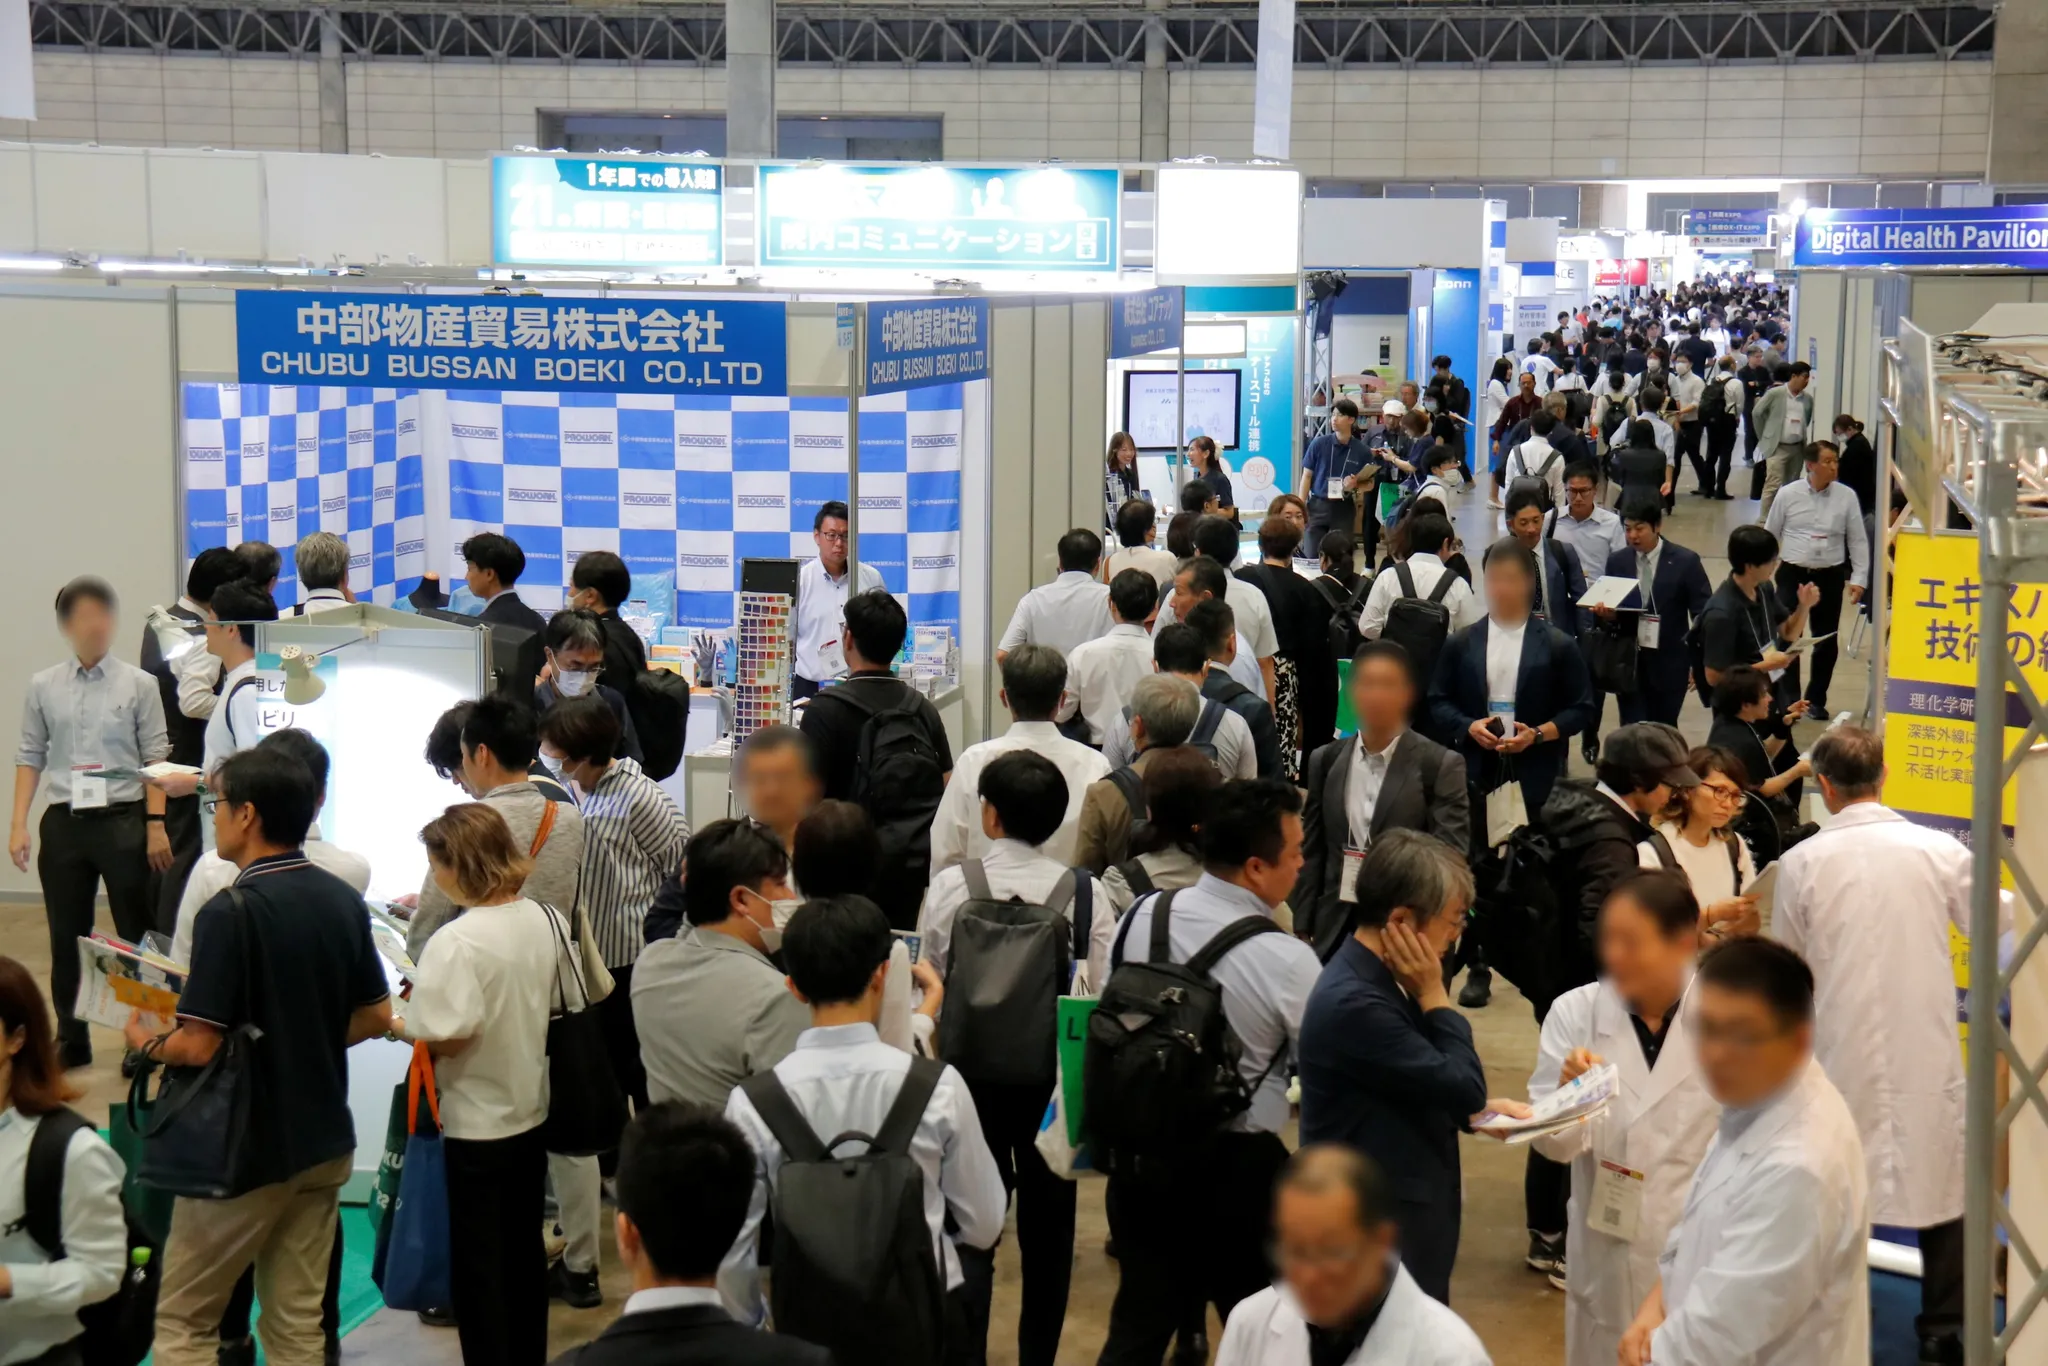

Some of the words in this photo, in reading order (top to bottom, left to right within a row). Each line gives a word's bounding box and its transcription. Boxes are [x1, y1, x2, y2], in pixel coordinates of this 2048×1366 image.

[1812, 224, 1879, 255] Digital
[1884, 224, 1956, 249] Health
[297, 301, 725, 353] 中部物産貿易株式会社
[882, 305, 977, 353] 中部物産貿易株式会社
[261, 351, 369, 376] CHUBU
[388, 354, 516, 380] BUSSAN
[534, 357, 625, 382] BOEKI
[643, 360, 763, 387] CO.,LTD
[872, 360, 899, 385] CHUBU
[903, 356, 933, 380] BUSSAN
[936, 353, 956, 376] BOEKI
